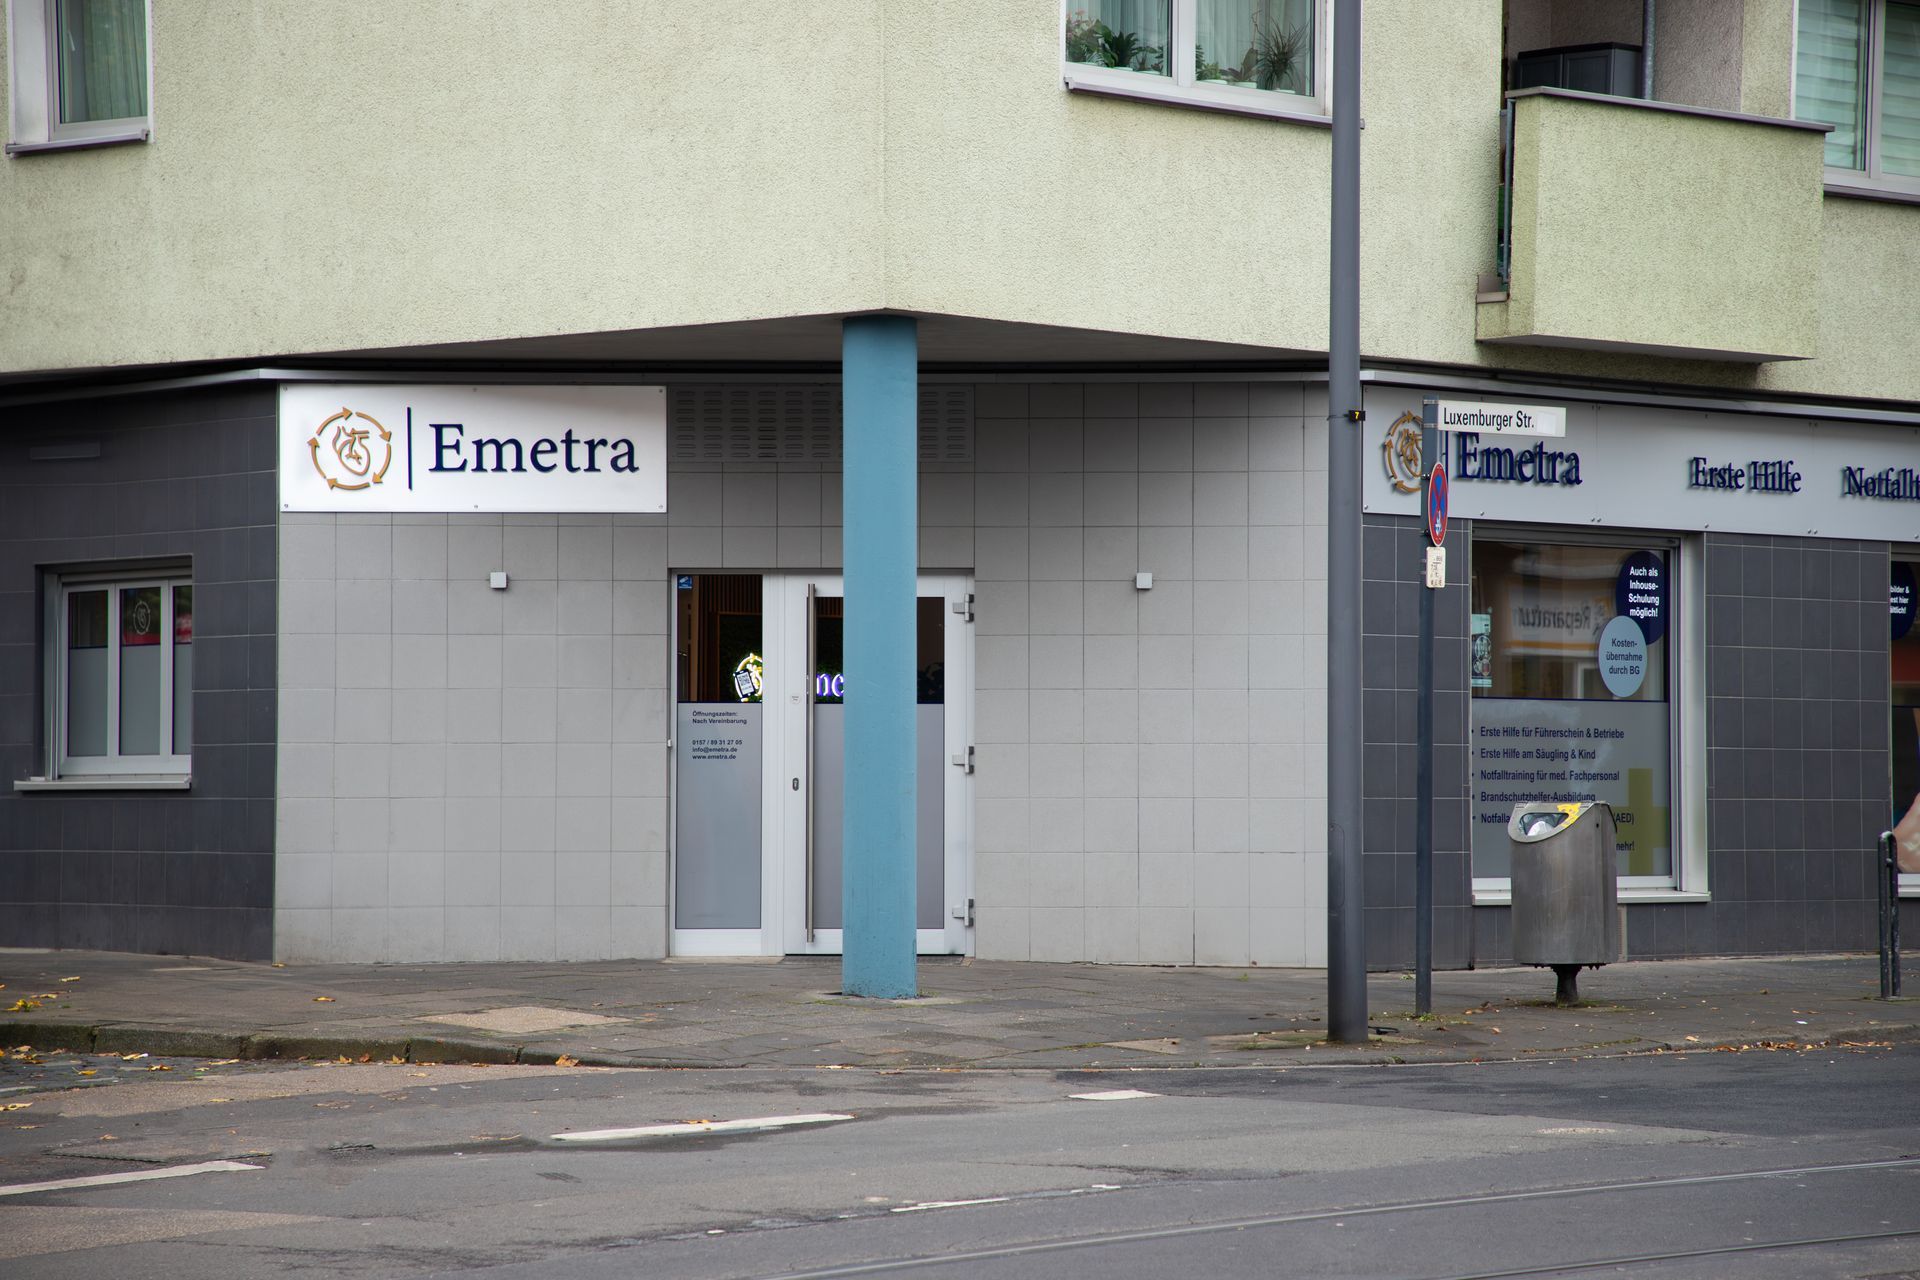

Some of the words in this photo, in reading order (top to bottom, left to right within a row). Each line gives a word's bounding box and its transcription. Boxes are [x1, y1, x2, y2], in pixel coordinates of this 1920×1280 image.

[1354, 411, 1360, 420] 7
[1443, 407, 1513, 431] Luxemburger
[1516, 410, 1535, 429] Str.
[428, 423, 640, 473] Emetra
[1457, 432, 1583, 485] Emetra
[1691, 456, 1745, 490] Erste
[1751, 460, 1802, 493] Hilfe
[1629, 566, 1647, 576] Auch
[1648, 567, 1659, 577] als
[1629, 580, 1659, 590] Inhouse-
[1628, 593, 1660, 606] Schulung
[1629, 607, 1658, 619] möglich!
[1611, 638, 1638, 648] Kosten-
[1606, 651, 1643, 662] übernahme
[1608, 665, 1628, 675] durch
[1629, 666, 1640, 675] BG
[692, 710, 738, 718] Öffnungszeiten:
[1480, 726, 1501, 737] Erste
[1502, 727, 1520, 737] Hilfe
[1521, 727, 1533, 737] für
[1534, 727, 1584, 738] Führerschein
[1585, 728, 1592, 738] &
[1593, 728, 1625, 739] Betriebe
[1480, 748, 1501, 759] Erste
[1502, 748, 1520, 759] Hilfe
[1522, 750, 1534, 759] am
[1535, 748, 1569, 762] Säugling
[1570, 749, 1577, 759] &
[1578, 749, 1596, 760] Kind
[1480, 769, 1535, 783] Notfalltraining
[1536, 770, 1548, 780] für
[1549, 770, 1567, 781] med.
[1569, 770, 1620, 783] Fachpersonal
[1480, 791, 1596, 802] Brandschutzhelfer-Ausbildung
